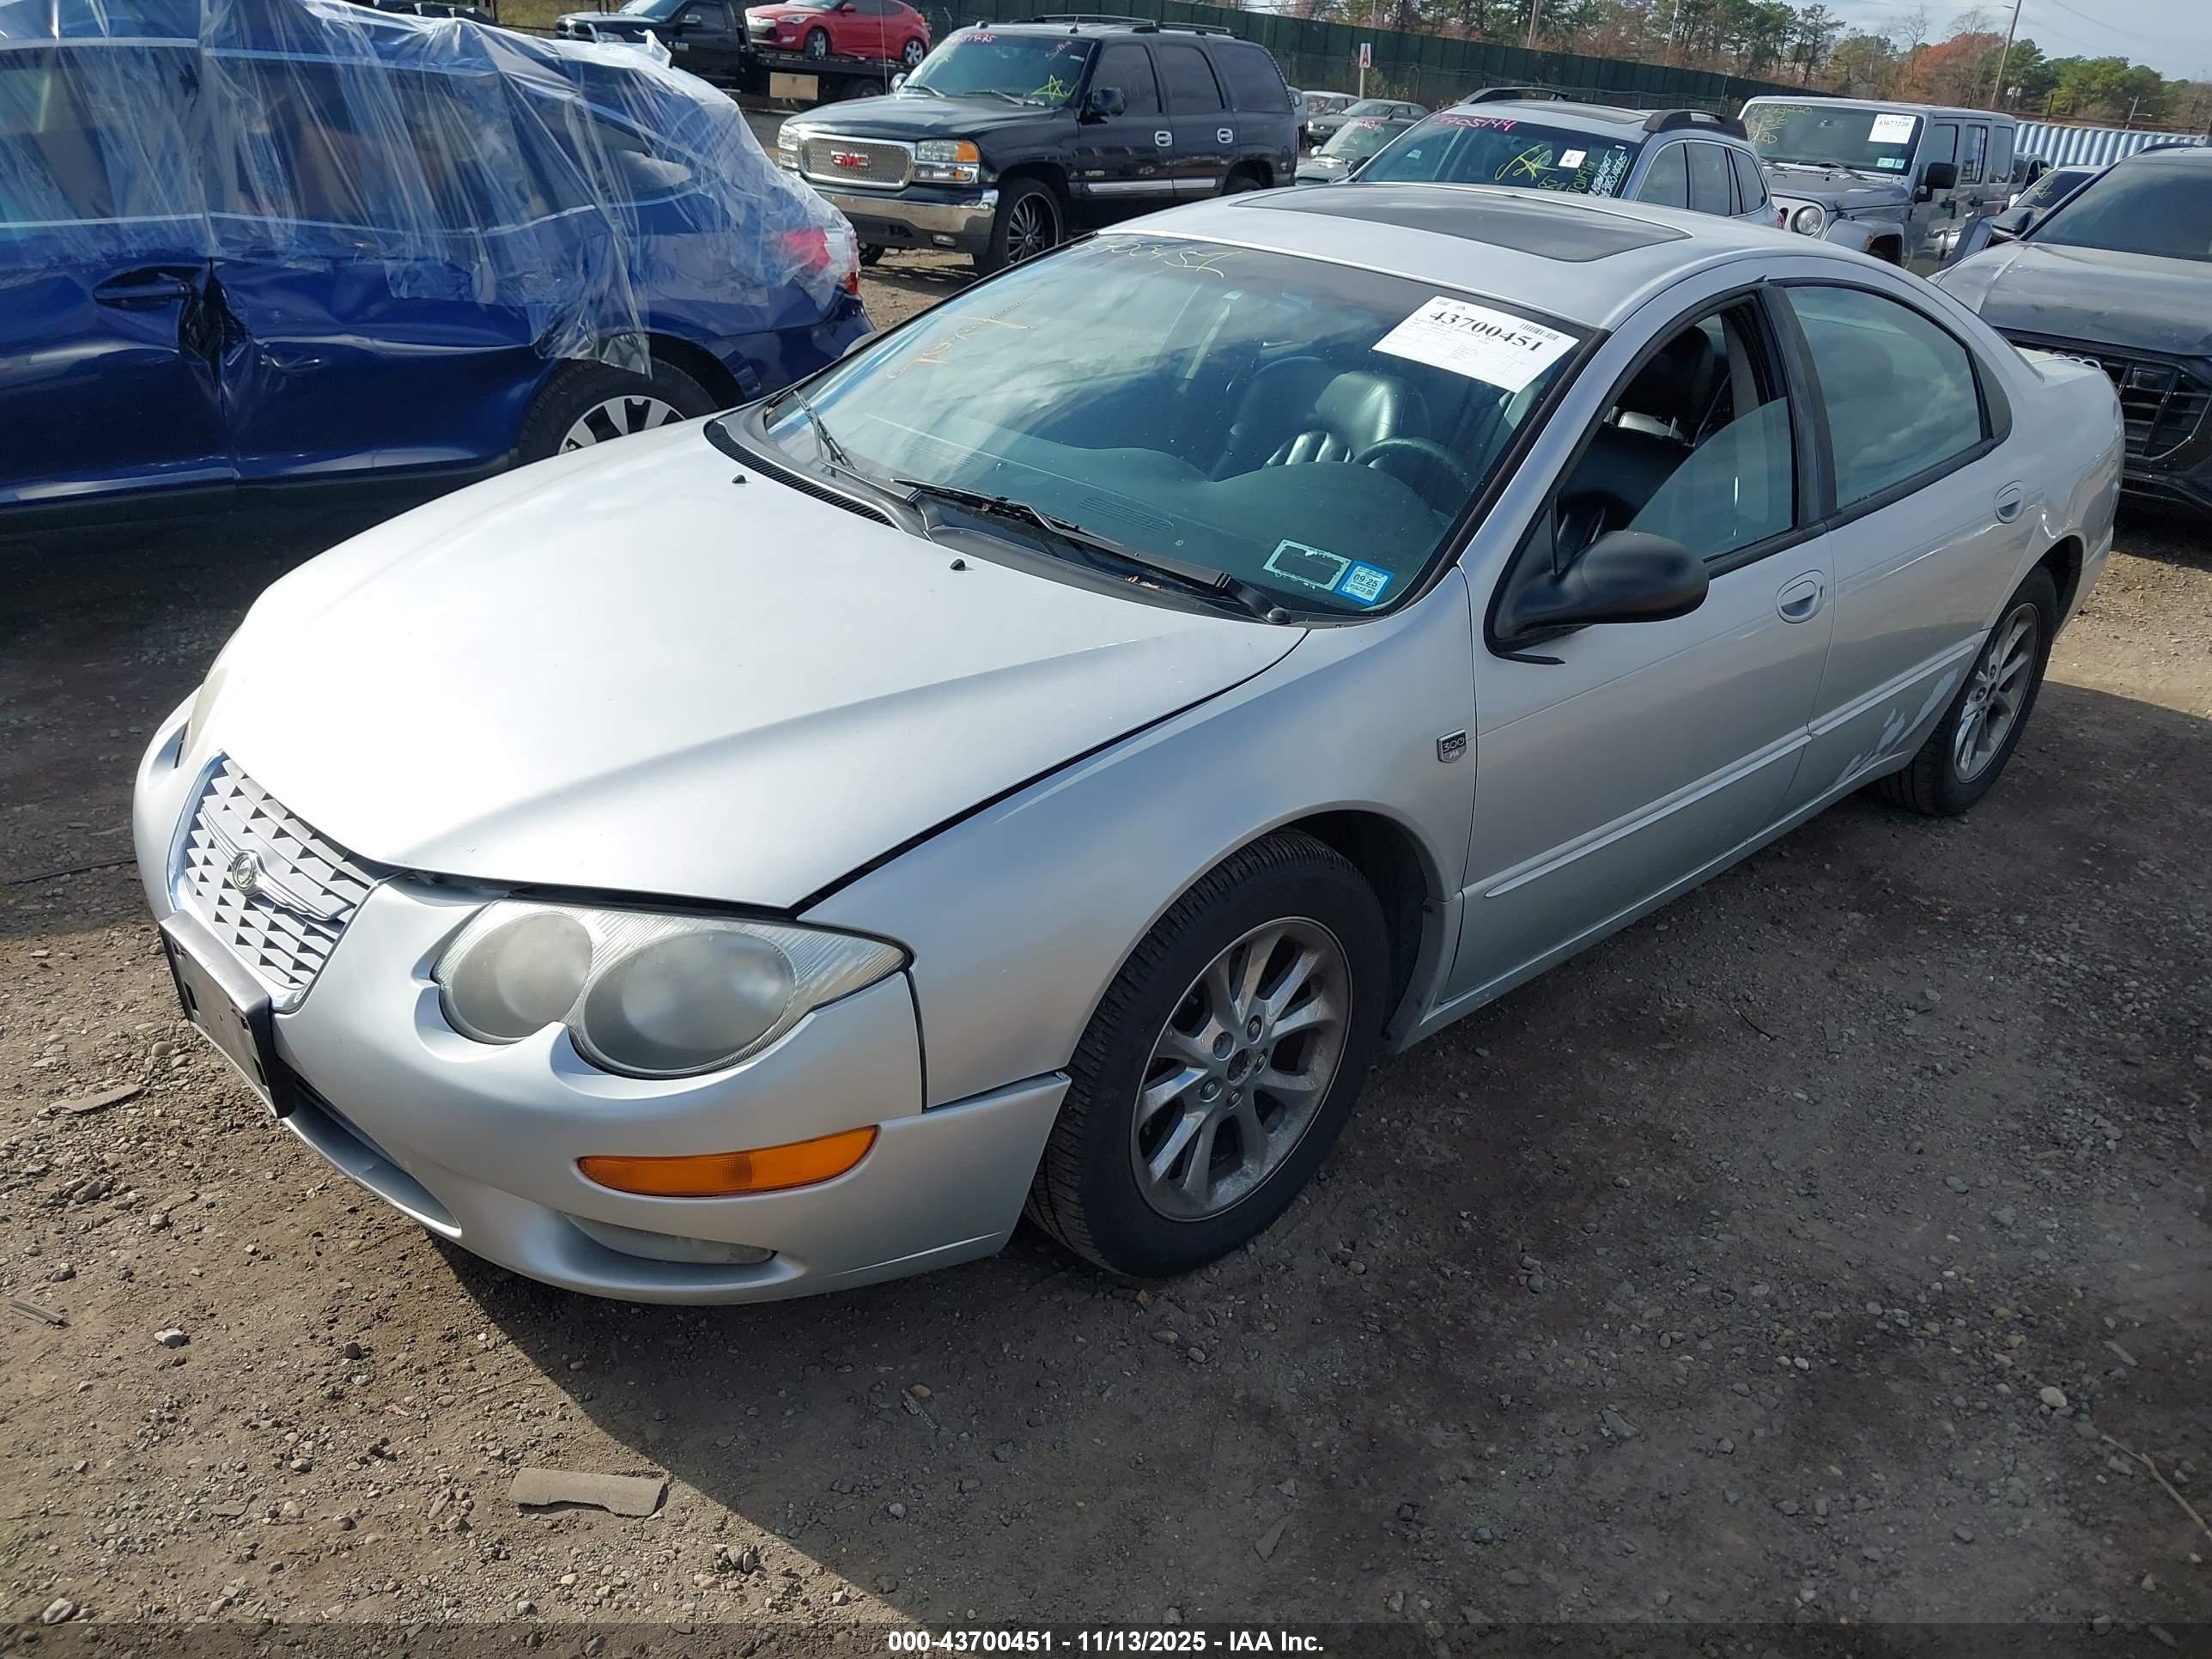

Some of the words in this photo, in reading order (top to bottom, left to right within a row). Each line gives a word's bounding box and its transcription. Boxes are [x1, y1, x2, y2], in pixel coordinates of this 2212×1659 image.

[830, 149, 869, 167] GMC
[1429, 311, 1543, 351] 43700451
[1443, 737, 1464, 752] 300
